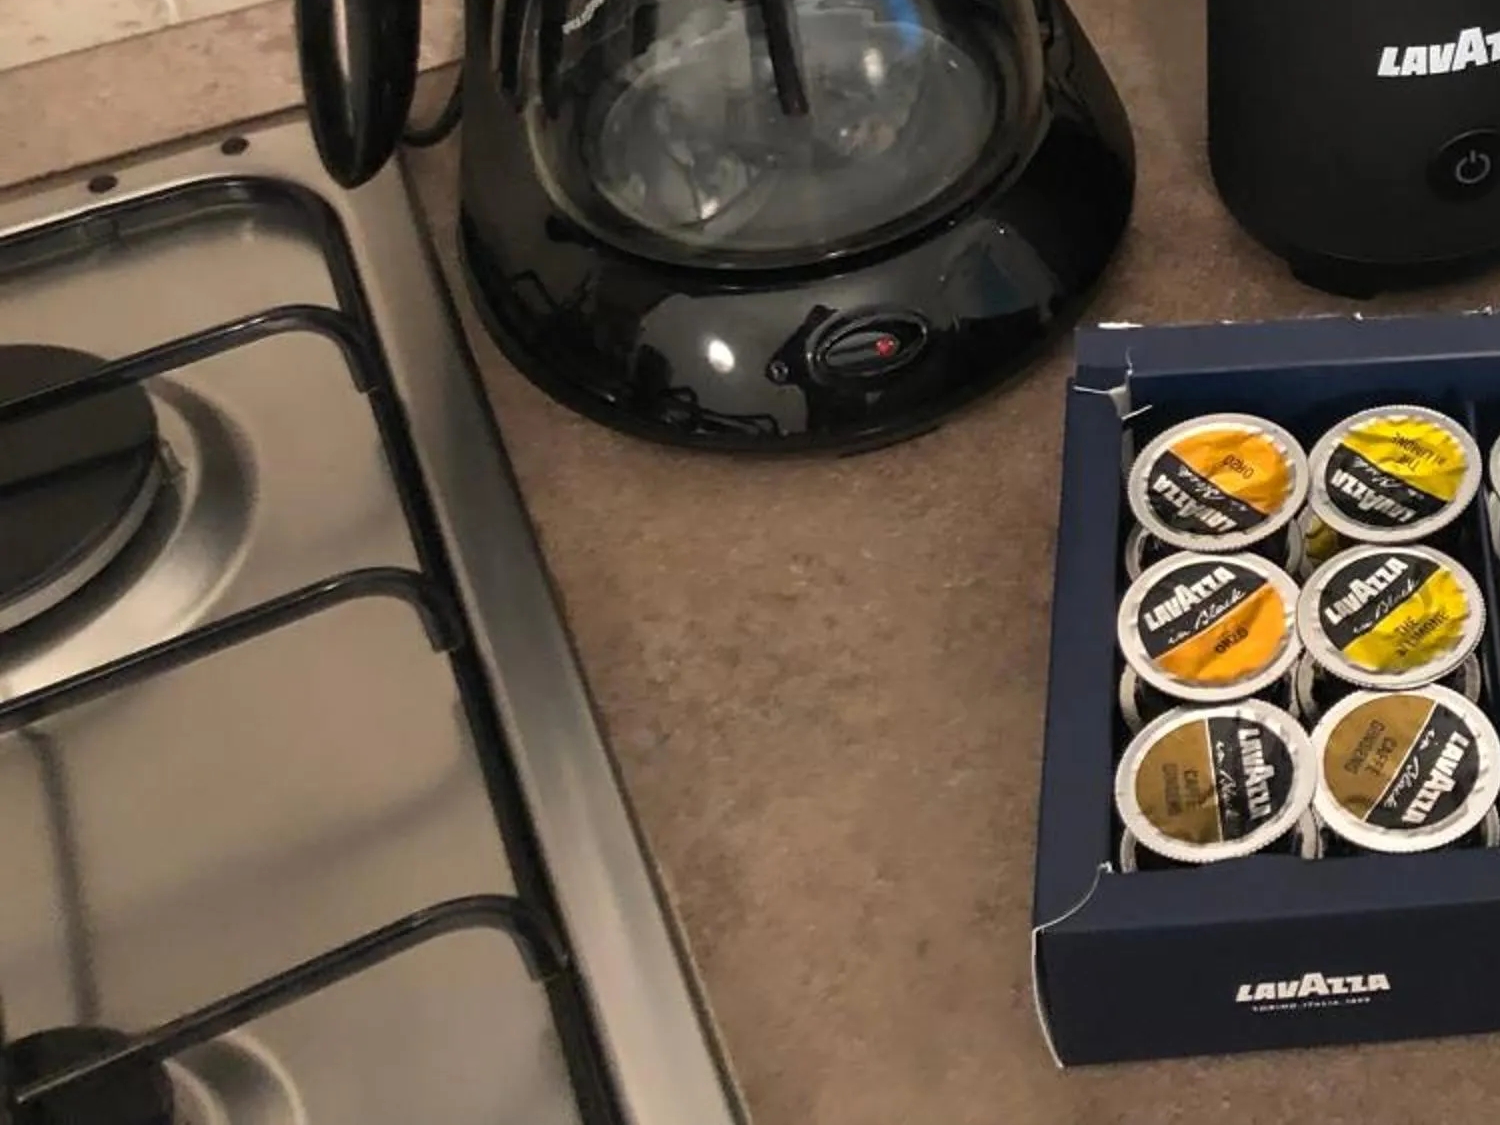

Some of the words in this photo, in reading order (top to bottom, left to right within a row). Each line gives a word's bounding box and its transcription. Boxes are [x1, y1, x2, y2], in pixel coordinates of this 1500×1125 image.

[1153, 475, 1238, 531] LAVAZZA
[1331, 469, 1416, 522] LAVAZZA
[1143, 566, 1236, 631] LAVAZZA
[1195, 588, 1246, 630] Black
[1325, 557, 1408, 625] LAVAZZA
[1214, 626, 1248, 653] ORZO
[1238, 728, 1275, 820] LAVAZZA
[1384, 756, 1419, 808] Black
[1402, 730, 1470, 823] LAVAZZA
[1235, 972, 1391, 1002] LAVAZZA
